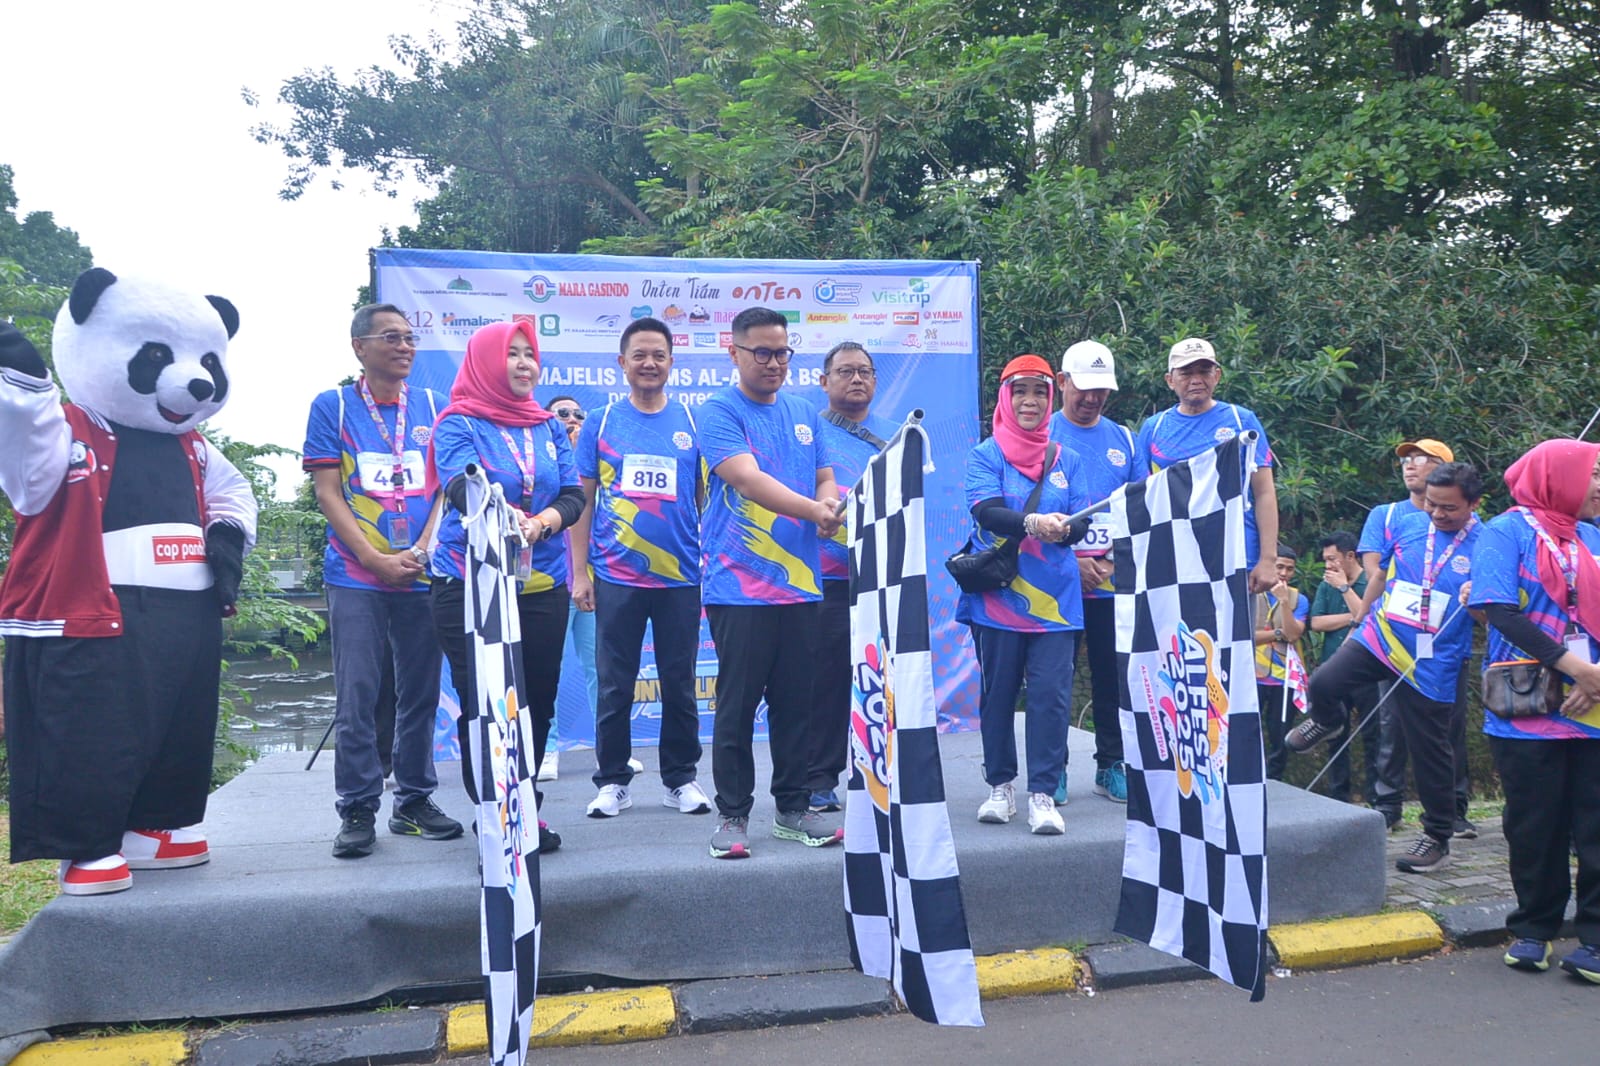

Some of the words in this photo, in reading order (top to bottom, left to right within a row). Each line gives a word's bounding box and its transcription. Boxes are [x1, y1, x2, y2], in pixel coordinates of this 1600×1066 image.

[559, 282, 586, 297] MARA
[588, 283, 629, 297] GASINDO
[642, 279, 680, 298] Onten
[872, 291, 931, 308] Visitrip
[442, 312, 503, 326] Himala
[933, 311, 963, 320] YAMAHA
[538, 367, 616, 386] MAJELIS
[799, 368, 823, 386] BS
[373, 468, 413, 486] 41
[633, 471, 667, 488] 818
[1074, 528, 1109, 545] 03
[156, 543, 179, 560] cap
[1168, 652, 1194, 772] 2025
[1180, 630, 1212, 785] ALFEST
